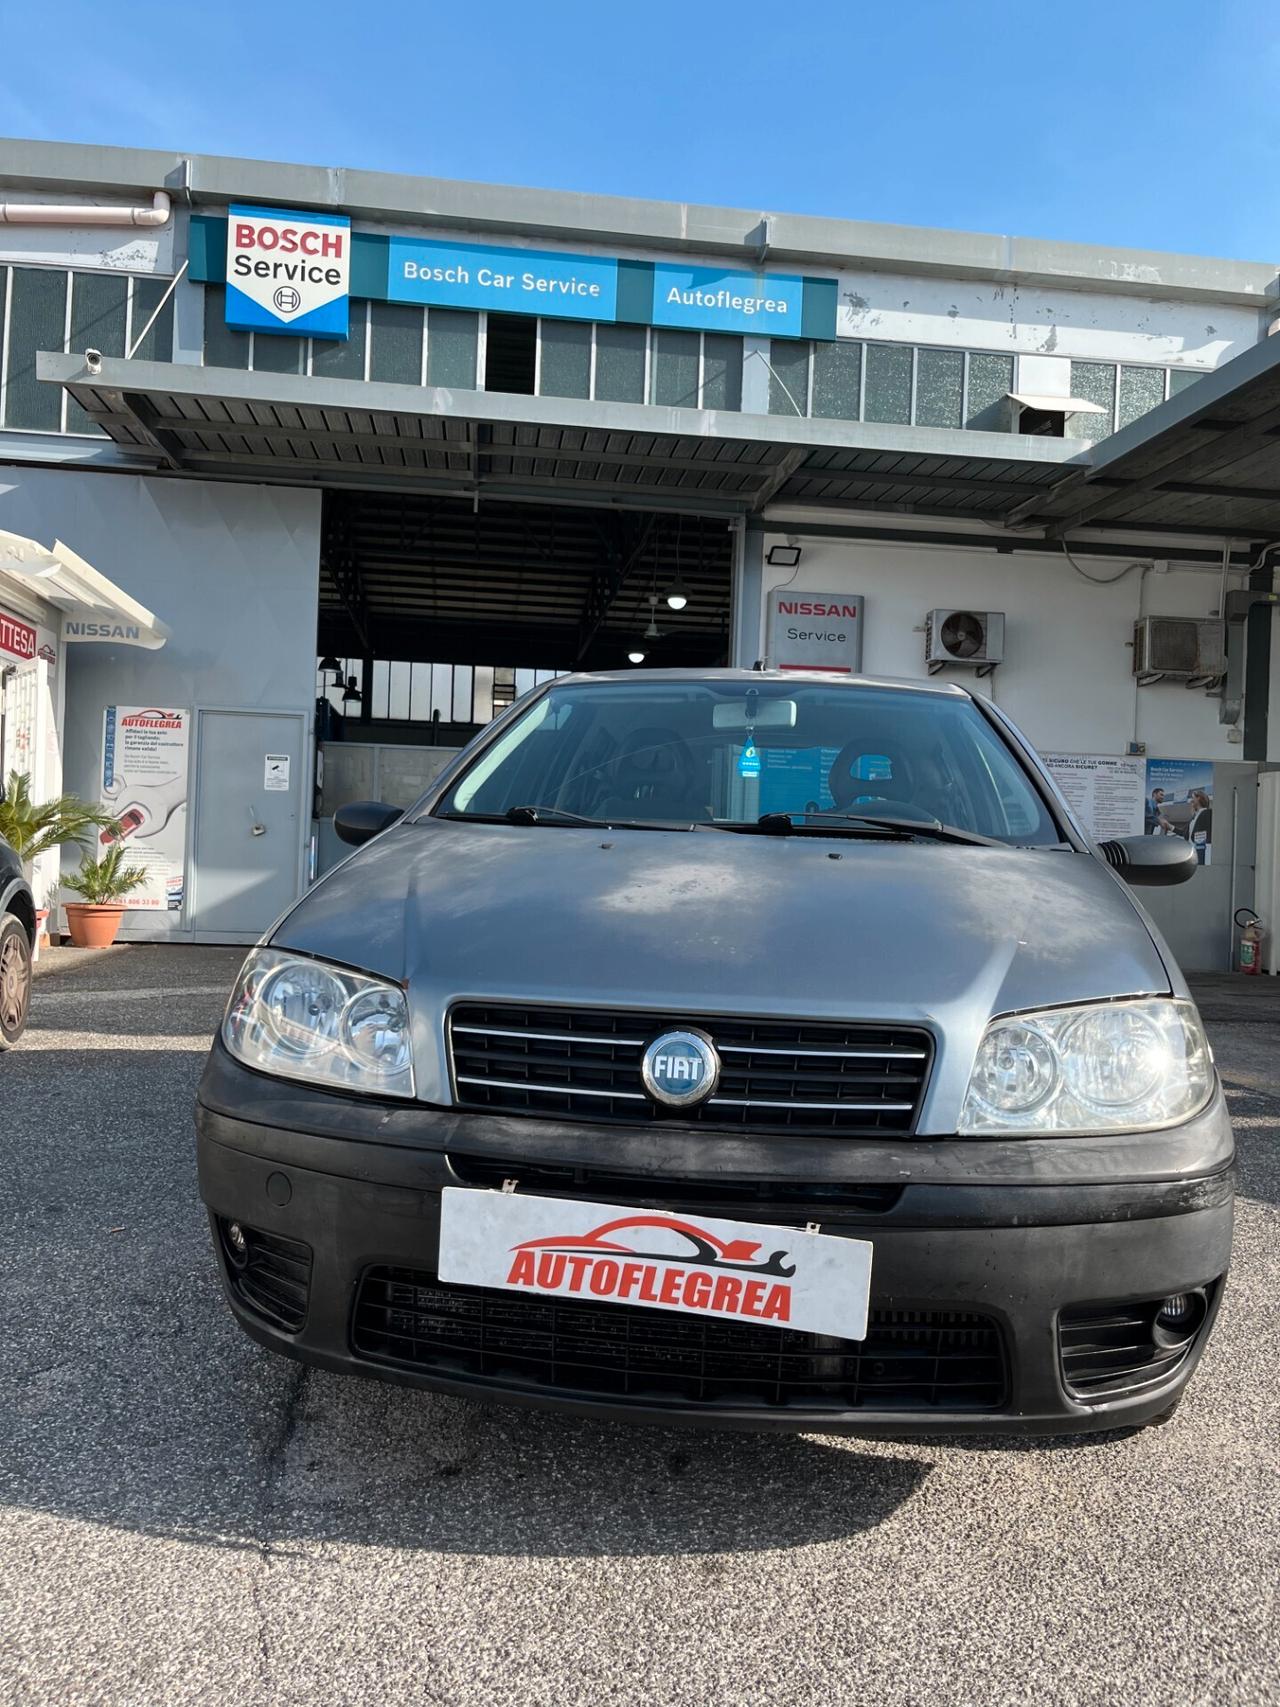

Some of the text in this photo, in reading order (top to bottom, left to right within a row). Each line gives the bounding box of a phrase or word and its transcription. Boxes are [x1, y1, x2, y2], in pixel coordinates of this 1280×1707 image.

[236, 224, 342, 258] BOSCH
[234, 254, 341, 286] Service
[404, 261, 600, 297] Bosch Car Service
[667, 287, 788, 314] Autoflegrea
[778, 601, 857, 618] NISSAN
[65, 622, 140, 639] NISSAN
[787, 627, 846, 642] Service
[121, 719, 182, 728] AUTOFLEGREA
[654, 1055, 702, 1080] FIAT
[506, 1250, 792, 1322] AUTOFLEGREA
